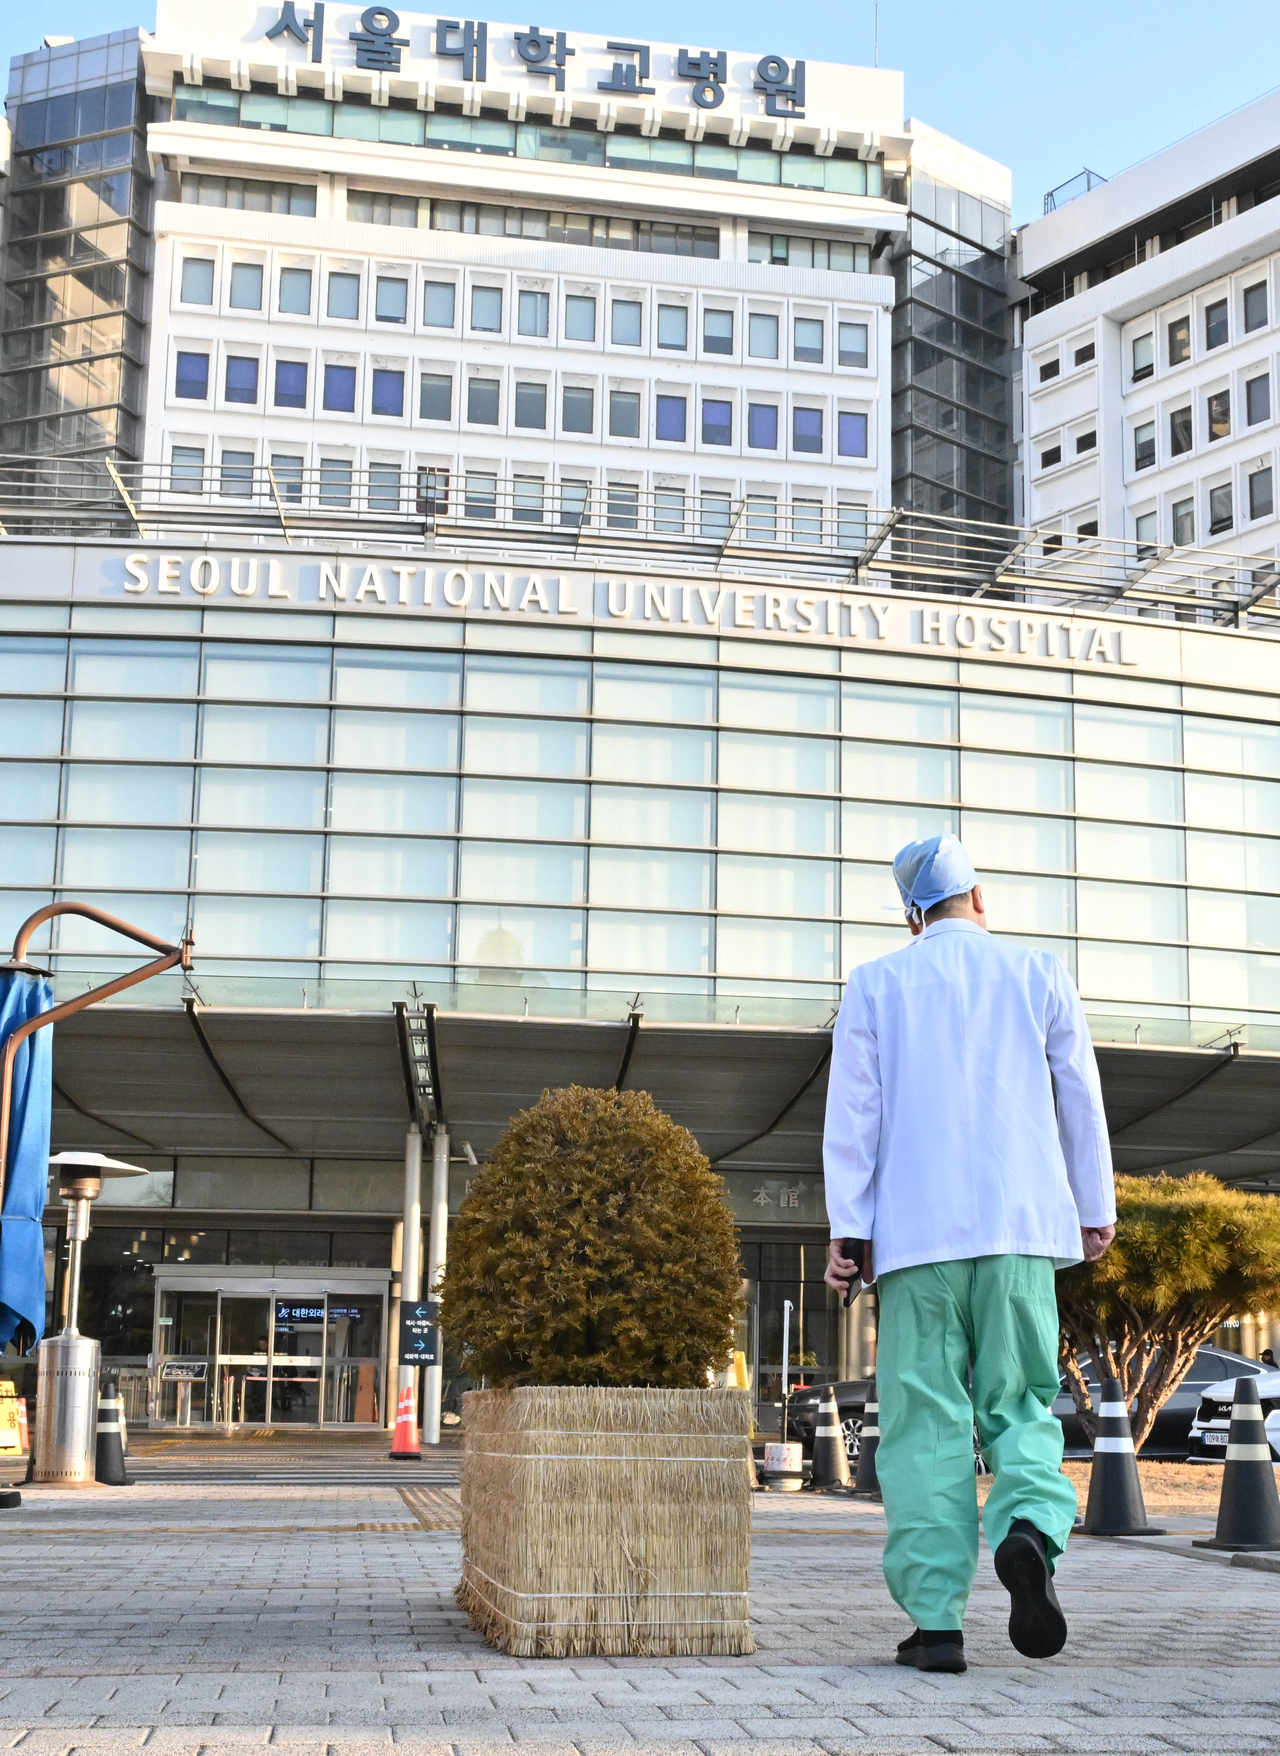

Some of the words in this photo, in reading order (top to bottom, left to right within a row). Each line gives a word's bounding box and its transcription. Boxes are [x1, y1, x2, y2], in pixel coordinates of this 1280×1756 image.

[265, 0, 806, 119] 서울대학교병원
[123, 553, 290, 599] SEOUL
[318, 561, 578, 615] NATIONAL
[607, 578, 896, 640] UNIVERSITY
[922, 607, 1138, 666] HOSPITAL
[752, 1186, 800, 1207] 本館
